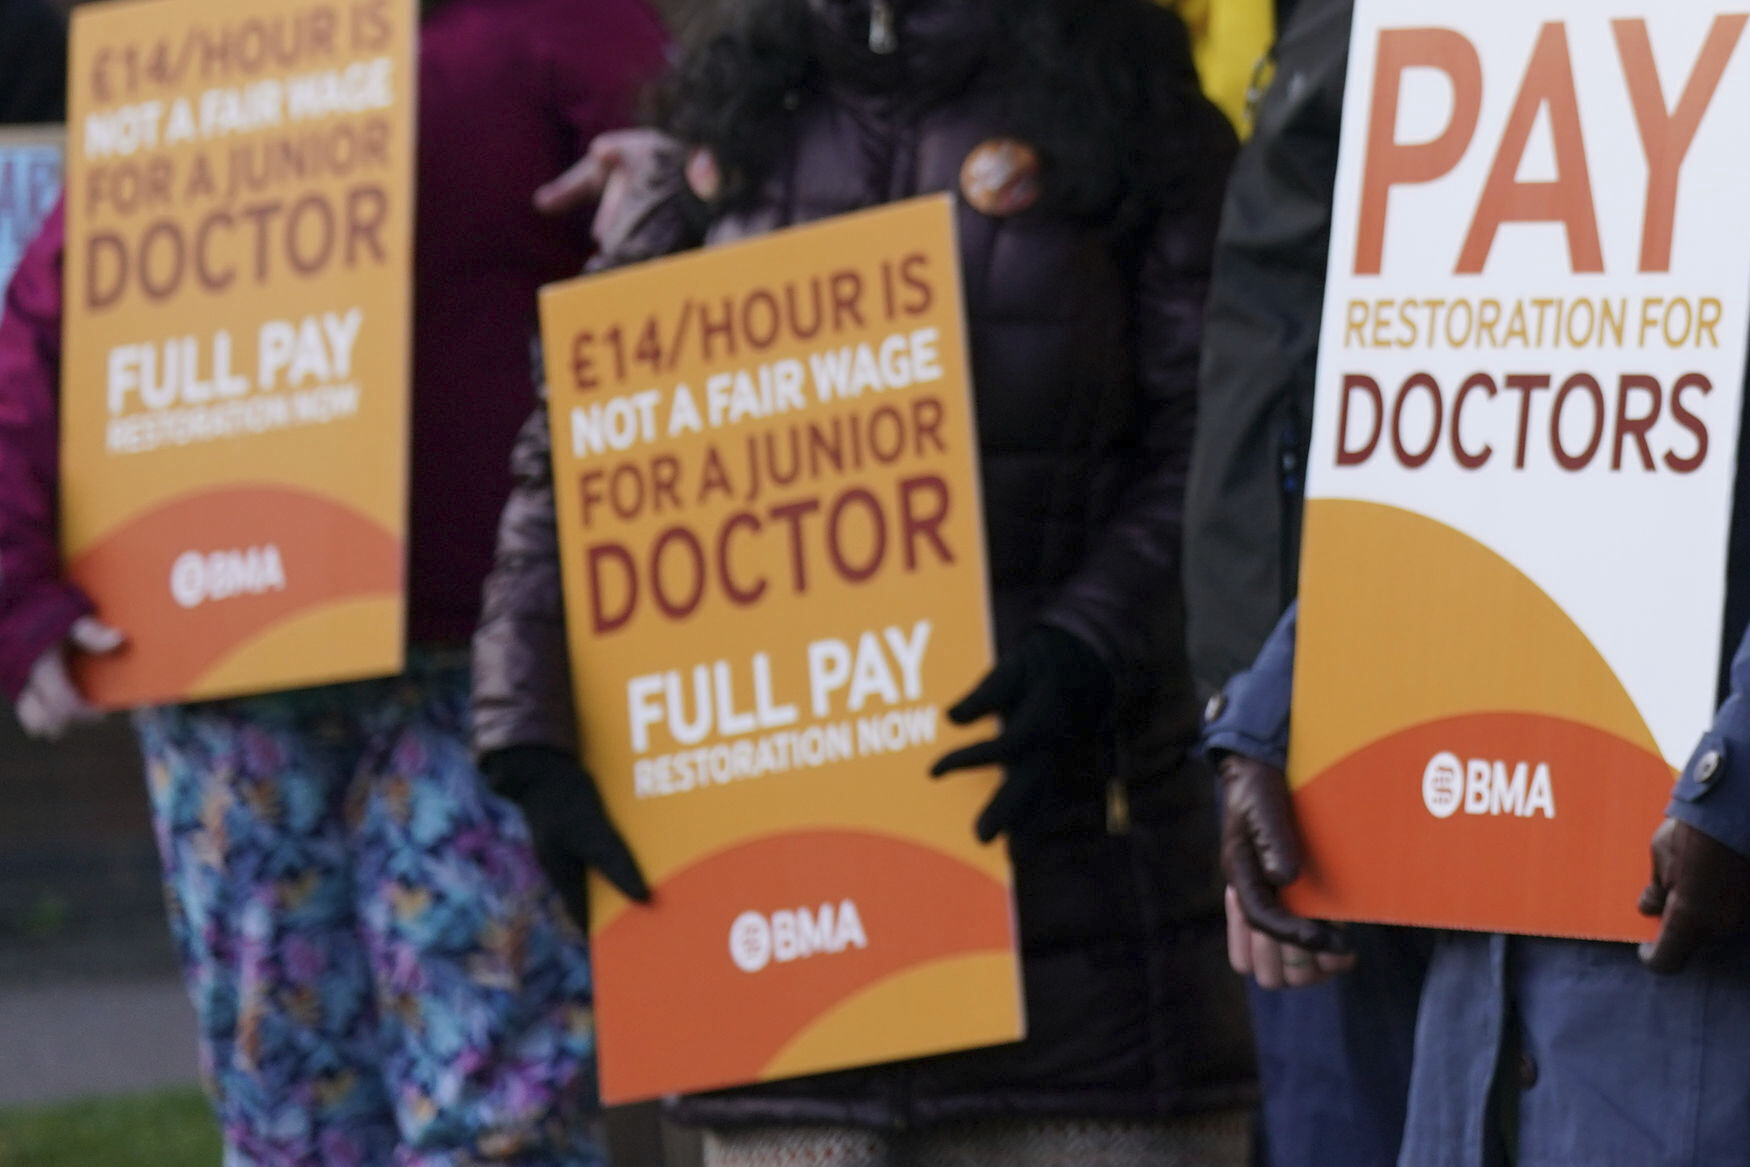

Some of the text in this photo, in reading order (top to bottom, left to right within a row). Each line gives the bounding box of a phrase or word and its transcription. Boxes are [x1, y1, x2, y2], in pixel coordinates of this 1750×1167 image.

[85, 57, 395, 160] NOT A FAIR WAGE
[91, 9, 338, 104] £14/HOUR
[86, 152, 172, 220] FOR
[184, 146, 221, 202] A
[226, 118, 391, 201] JUNIOR
[1350, 11, 1750, 277] PAY
[85, 184, 391, 312] DOCTOR
[107, 308, 363, 416] FULL PAY
[568, 252, 934, 394] £14/HOUR IS
[1343, 296, 1723, 351] RESTORATION FOR
[570, 328, 944, 459] NOT A FAIR WAGE
[1333, 370, 1714, 475] DOCTORS
[580, 396, 949, 528] FOR A JUNIOR
[587, 472, 956, 639] DOCTOR
[628, 621, 932, 756] FULL PAY
[633, 705, 939, 801] RESTORATION NOW
[1464, 757, 1556, 822] BMA
[773, 898, 868, 964] BMA
